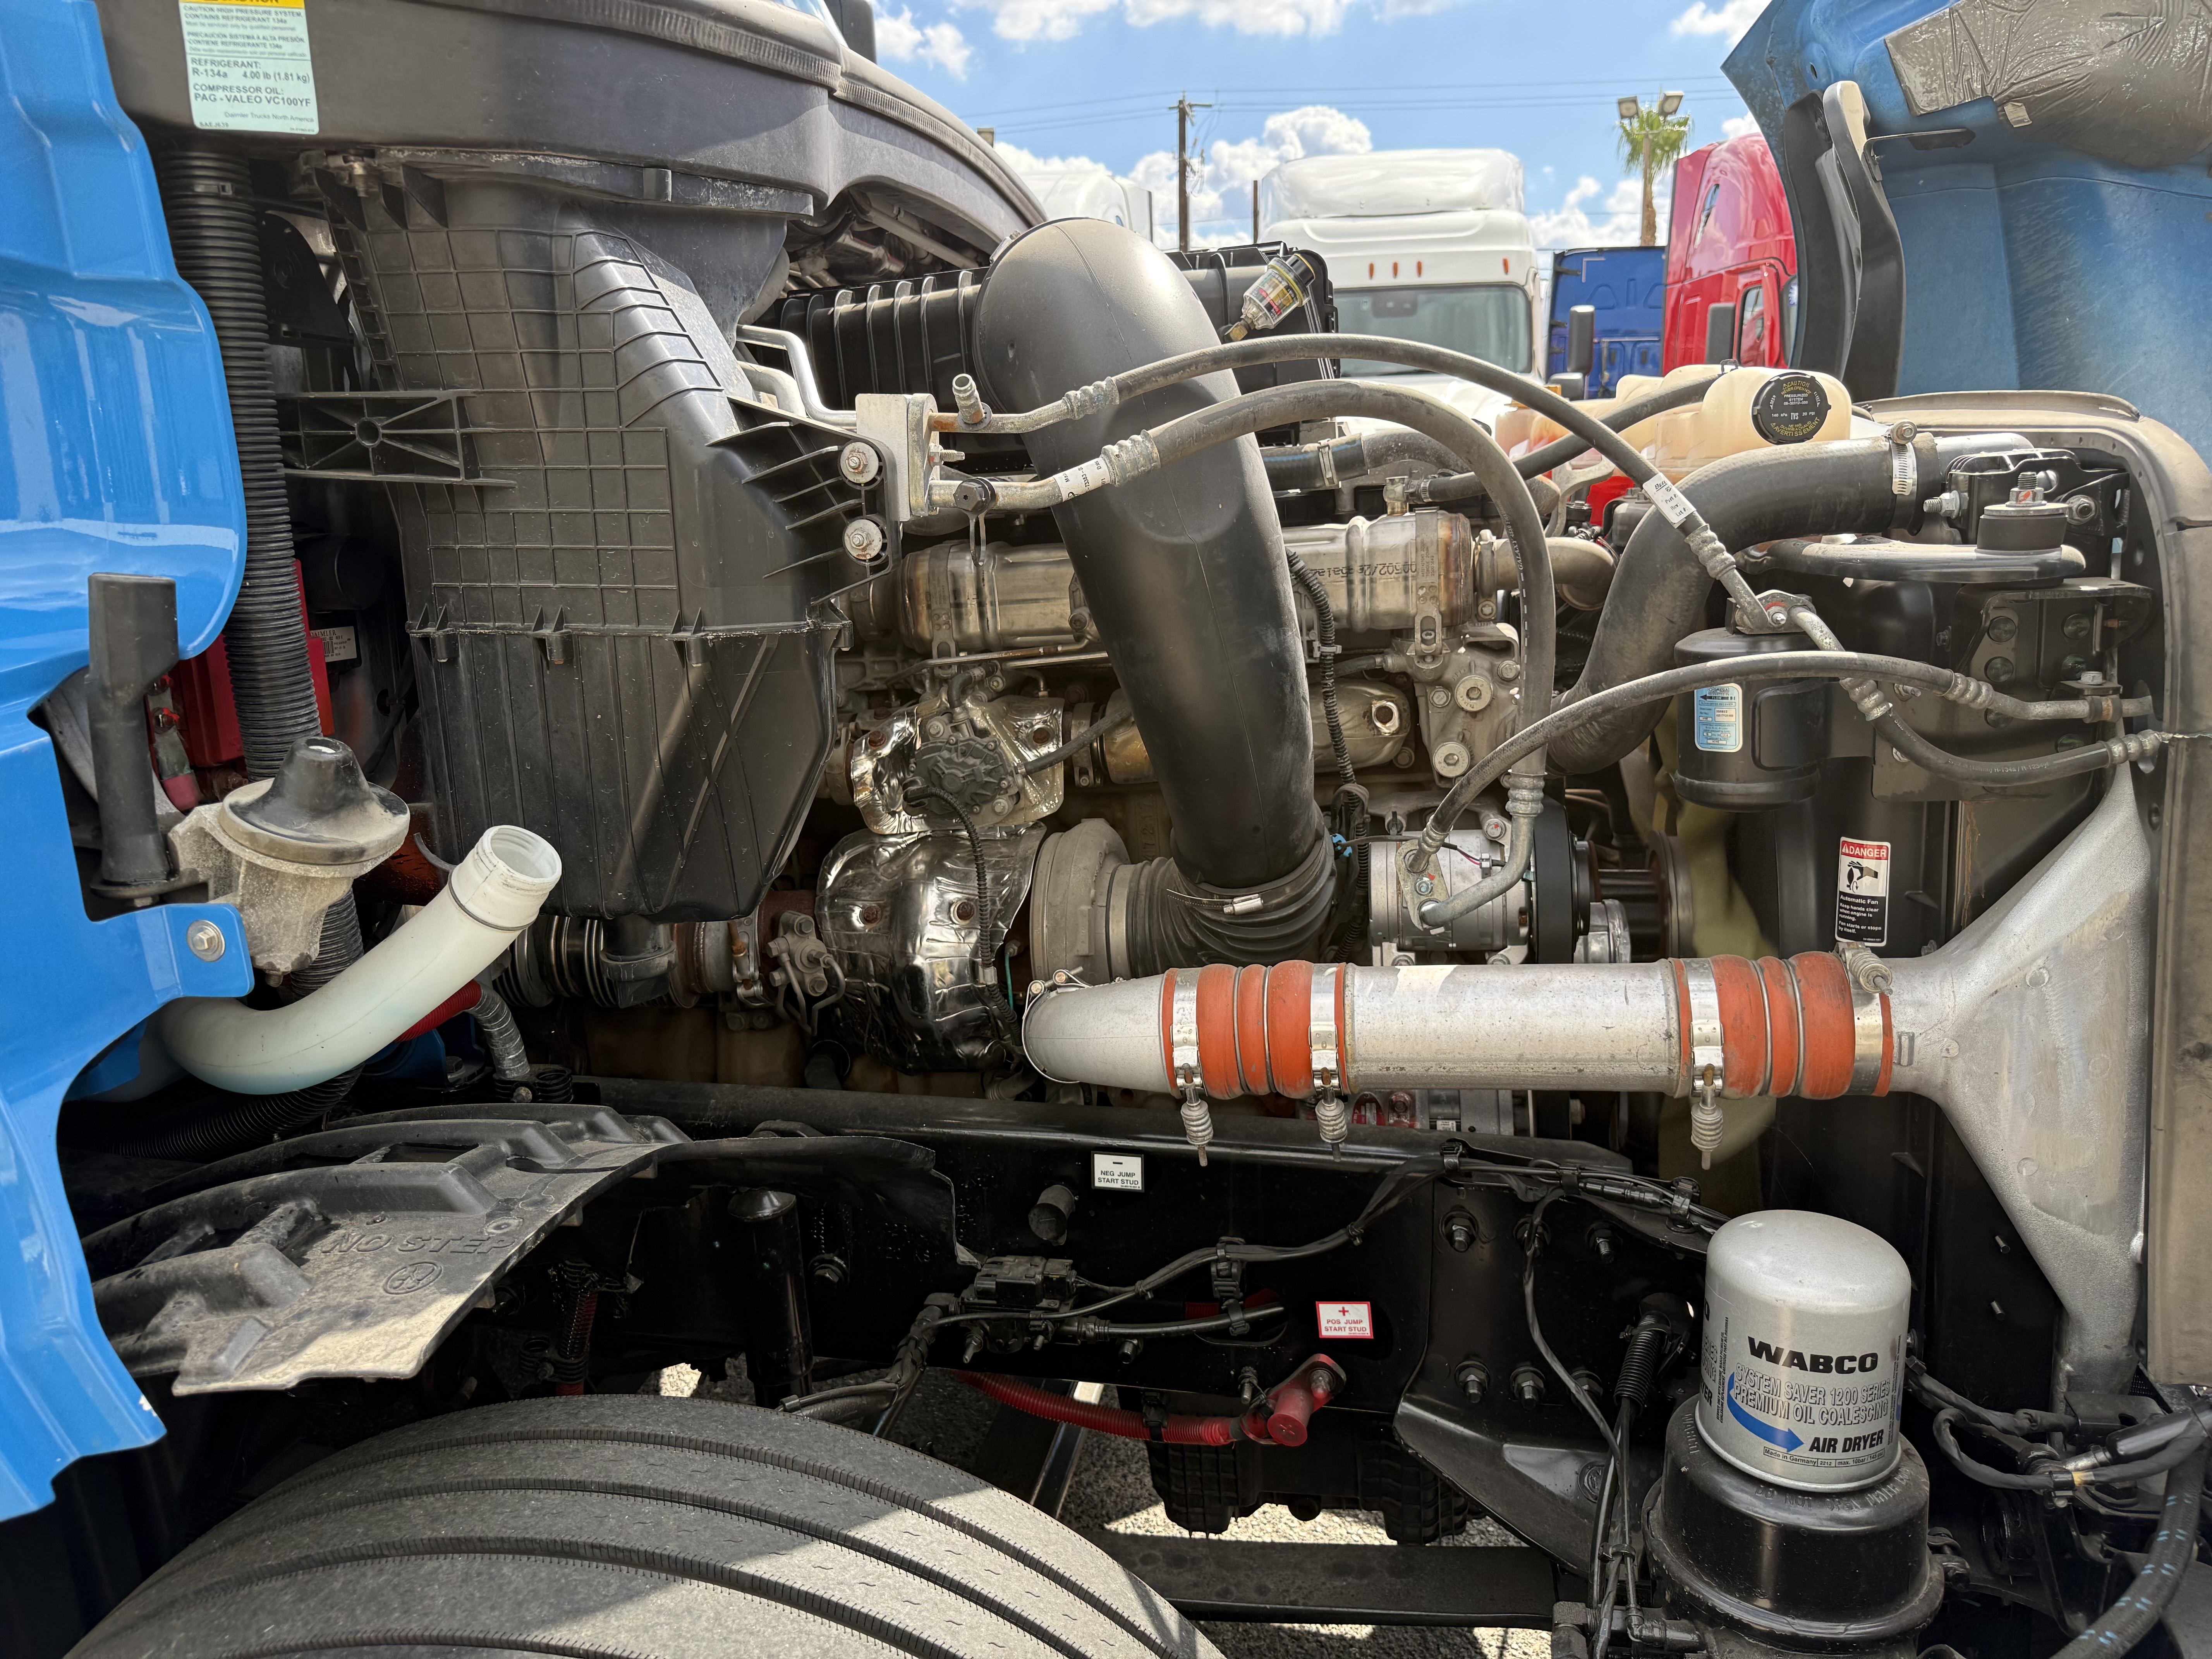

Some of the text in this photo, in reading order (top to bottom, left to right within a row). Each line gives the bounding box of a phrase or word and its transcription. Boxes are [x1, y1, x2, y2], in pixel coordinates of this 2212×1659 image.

[191, 57, 261, 69] REFRIGERANT:
[192, 67, 310, 84] R-134a 4.00 lb (1.81 kg)
[194, 83, 284, 95] COMPRESSOR OIL:
[194, 93, 217, 102] PAG
[225, 94, 262, 104] VALEO
[265, 96, 311, 106] VC100YF
[1512, 541, 1523, 570] GALAXY
[1849, 846, 1886, 857] DANGER
[1840, 895, 1866, 904] Automatic
[321, 1234, 516, 1254] NO STEP
[1748, 1335, 1878, 1374] WABCO
[1736, 1362, 1781, 1398] SYSTEM
[1784, 1381, 1826, 1405] SAVER
[1830, 1387, 1858, 1406] 1200
[1860, 1377, 1891, 1403] SERIES
[1734, 1381, 1889, 1426] PREMIUM OIL COALESCING
[1809, 1429, 1884, 1453] AIR DRYER
[1765, 1448, 1781, 1458] Made
[1790, 1456, 1817, 1466] Germany
[1755, 1484, 1776, 1499] DO
[1784, 1493, 1812, 1509] NOT
[1823, 1495, 1862, 1511] OPEN
